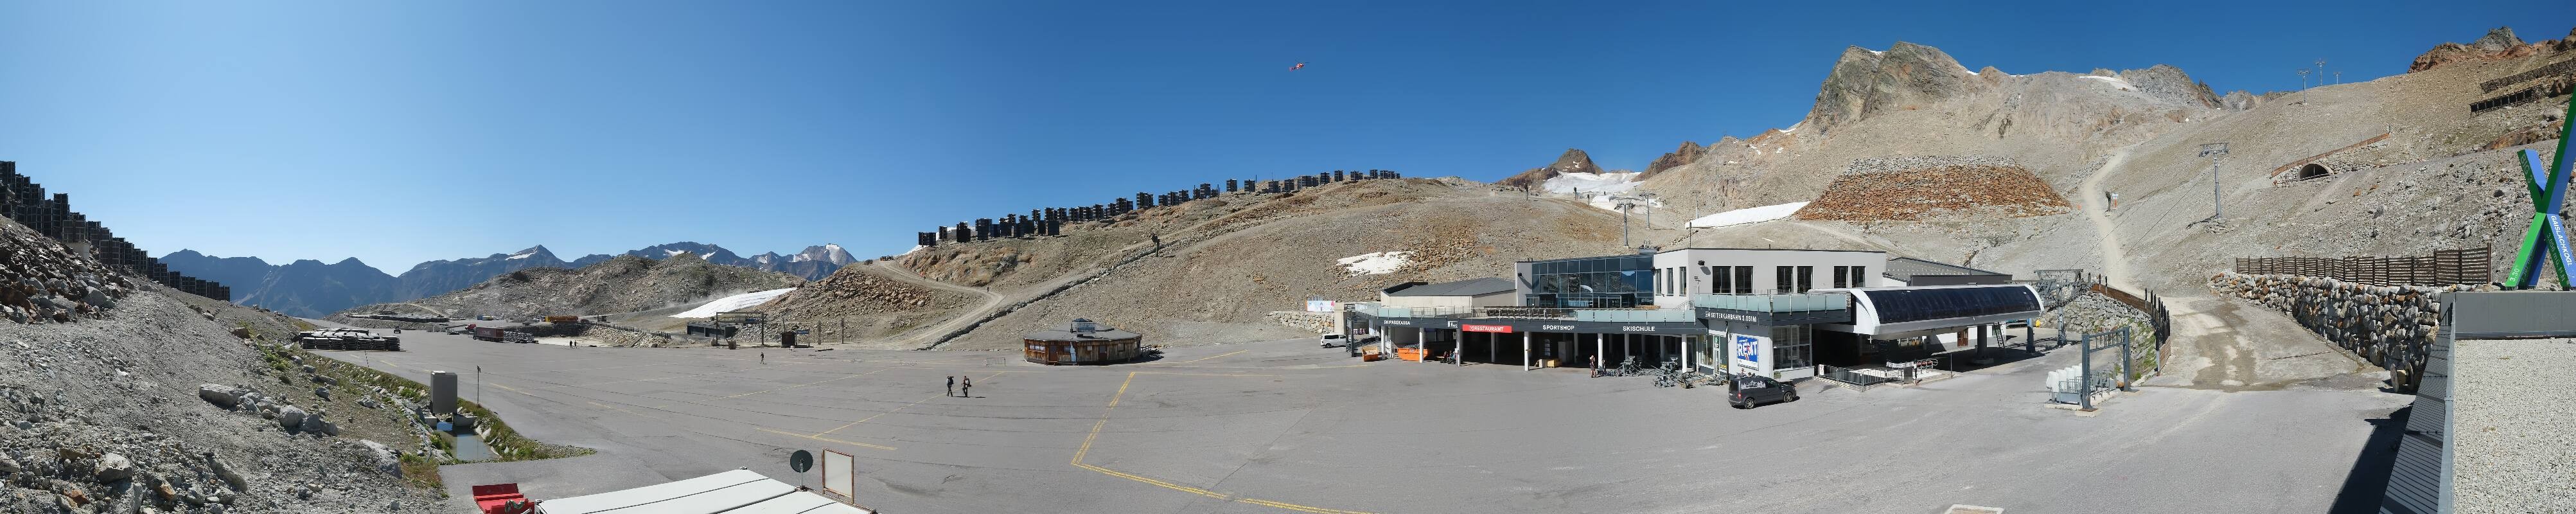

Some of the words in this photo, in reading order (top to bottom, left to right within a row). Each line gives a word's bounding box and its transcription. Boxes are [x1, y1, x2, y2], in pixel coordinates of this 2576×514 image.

[2520, 154, 2530, 174] BIG
[2527, 175, 2533, 184] 3
[2551, 215, 2573, 267] GAISLACHKOGL
[2510, 266, 2520, 281] 3.30
[1711, 312, 1742, 321] SEITERKARBAHN
[1738, 342, 1758, 357] RENT
